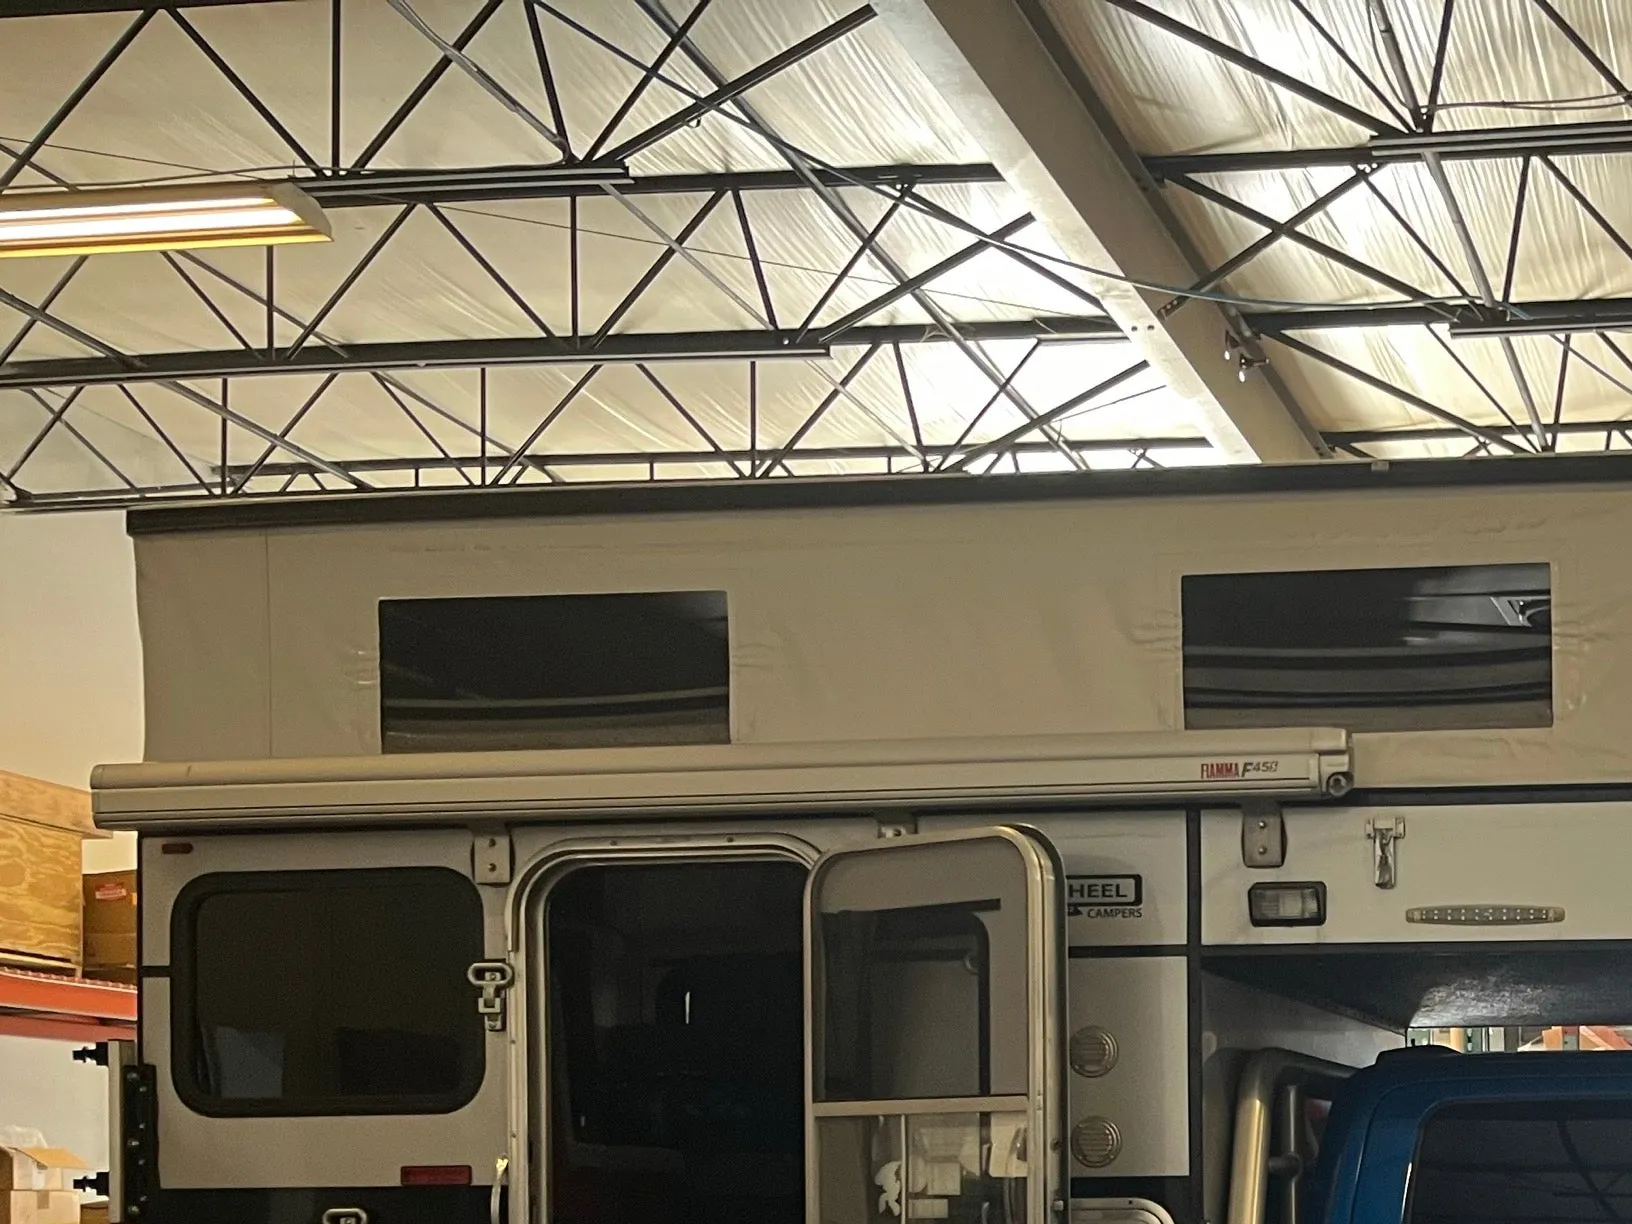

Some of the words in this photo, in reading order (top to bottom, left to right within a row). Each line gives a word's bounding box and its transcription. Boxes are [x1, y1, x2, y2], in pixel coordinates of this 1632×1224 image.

[1200, 763, 1240, 779] FIAMMA
[1066, 883, 1128, 898] HEEL
[1087, 907, 1143, 919] CAMPERS
